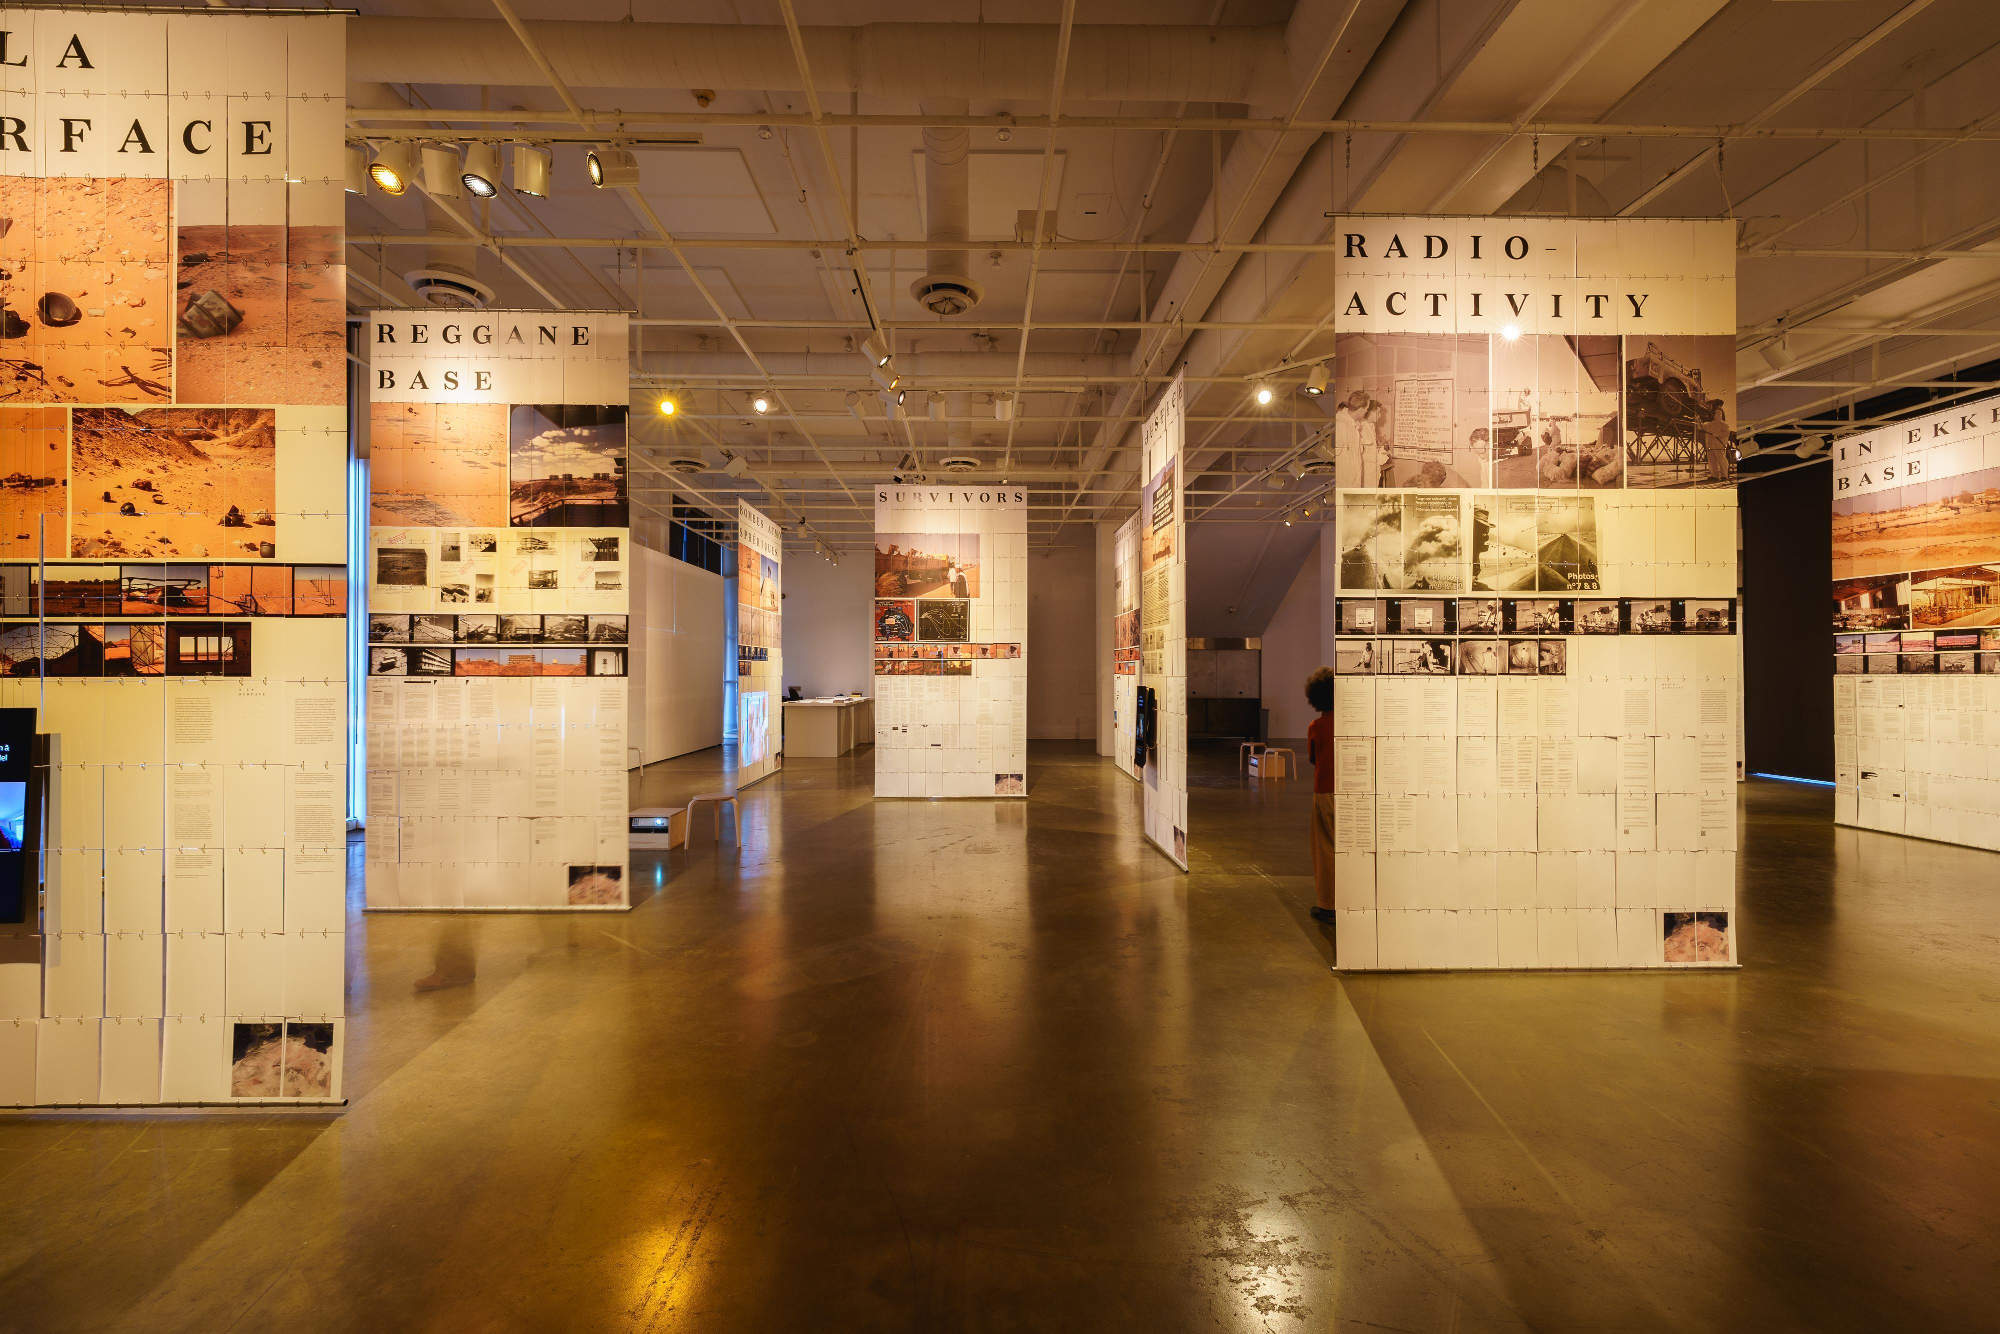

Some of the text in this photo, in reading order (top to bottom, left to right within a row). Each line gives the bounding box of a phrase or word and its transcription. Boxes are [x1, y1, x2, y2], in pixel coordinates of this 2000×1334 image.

[0, 116, 273, 155] RFACE
[1343, 233, 1557, 260] RADIO-
[1343, 290, 1649, 319] ACTIVITY
[377, 323, 590, 346] REGGANE
[377, 369, 493, 392] BASE
[1839, 440, 1873, 462] IN
[1837, 460, 1921, 492] BASE
[878, 491, 1024, 504] SURVIVORS
[1567, 572, 1596, 580] Photos
[1583, 582, 1591, 590] &
[1592, 582, 1598, 590] 8
